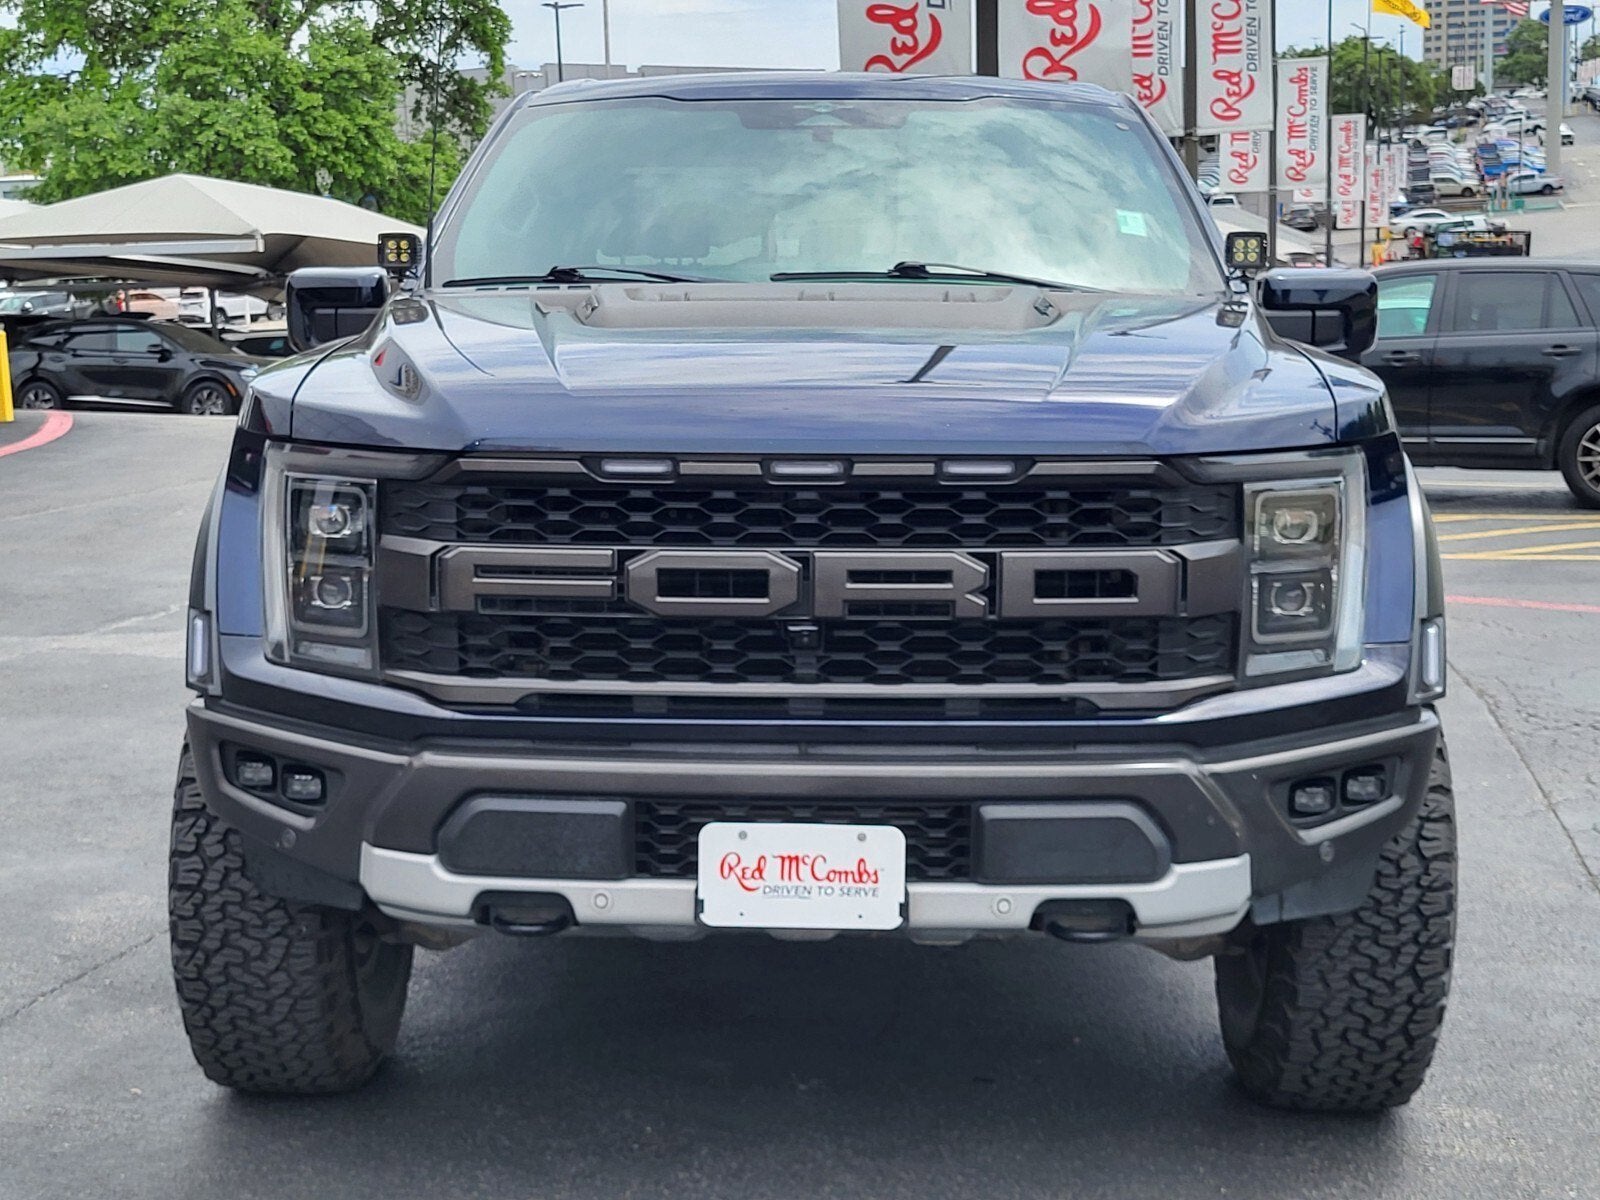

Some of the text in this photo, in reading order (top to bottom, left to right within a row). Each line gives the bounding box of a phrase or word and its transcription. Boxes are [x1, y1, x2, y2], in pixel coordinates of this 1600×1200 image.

[1023, 0, 1101, 81] Red
[1157, 21, 1169, 76] DRIVEN
[1246, 17, 1257, 72] DRIVEN
[1210, 68, 1255, 121] Red
[1287, 67, 1309, 144] McCombs
[1309, 98, 1318, 111] TO
[1309, 115, 1320, 151] DRIVEN
[1227, 152, 1257, 184] Red
[1285, 149, 1315, 182] Red
[439, 545, 1181, 619] FORD
[719, 851, 879, 892] Red McCombs
[762, 884, 879, 898] DRIVEN TO SERVE
